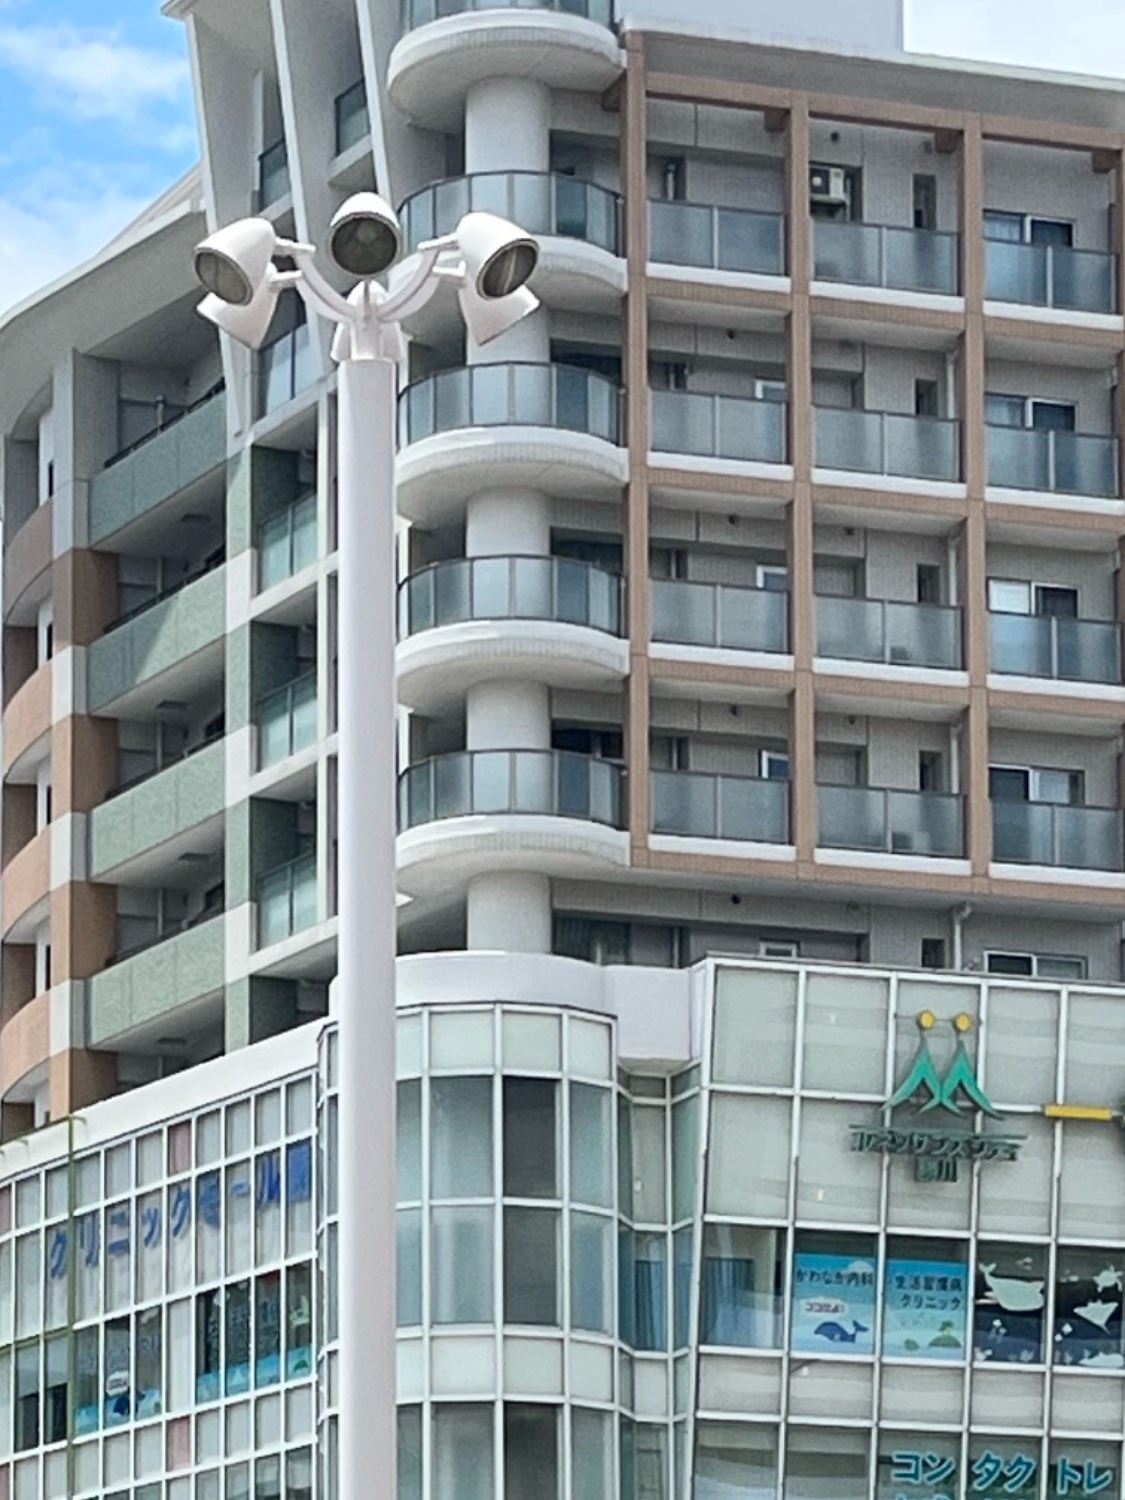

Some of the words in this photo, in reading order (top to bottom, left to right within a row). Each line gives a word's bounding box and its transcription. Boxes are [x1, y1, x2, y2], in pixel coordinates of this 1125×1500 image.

[901, 1294, 961, 1311] クリニック
